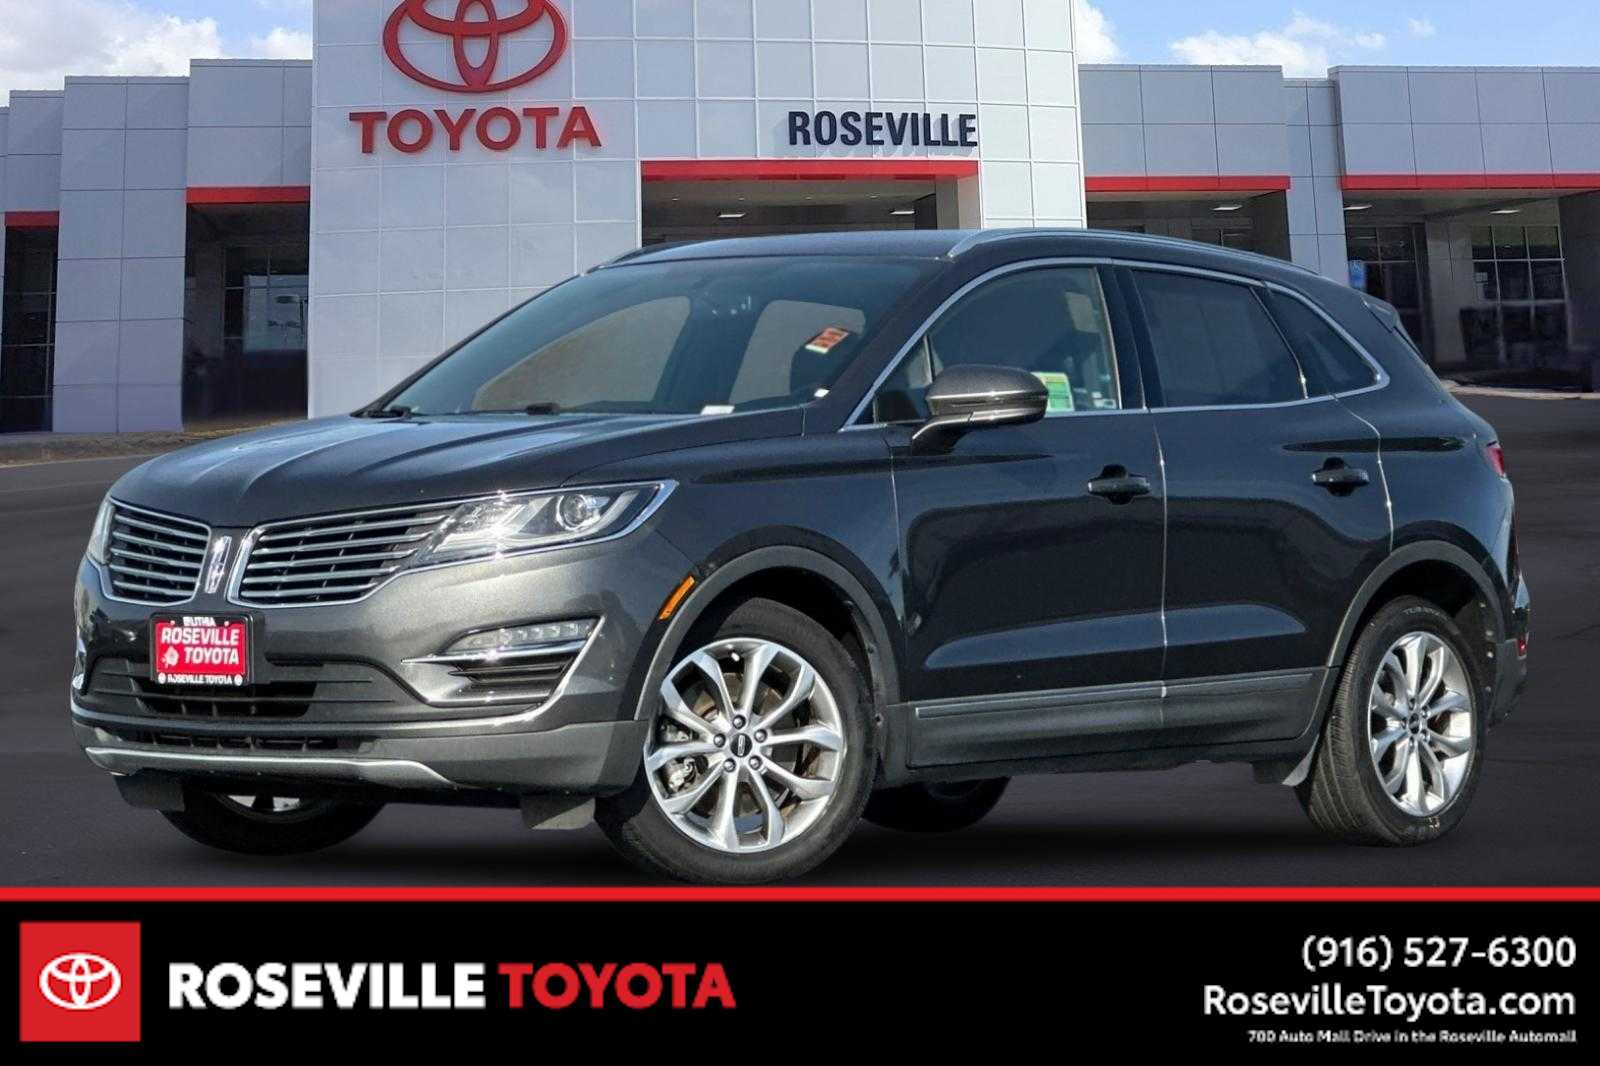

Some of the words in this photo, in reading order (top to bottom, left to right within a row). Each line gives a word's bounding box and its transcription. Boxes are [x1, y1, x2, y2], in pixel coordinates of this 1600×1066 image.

[349, 106, 603, 154] TOYOTA
[788, 110, 978, 147] ROSEVILLE
[161, 627, 240, 646] ROSEVILLE
[184, 646, 240, 665] TOYOTA
[205, 674, 233, 685] TOYOTA
